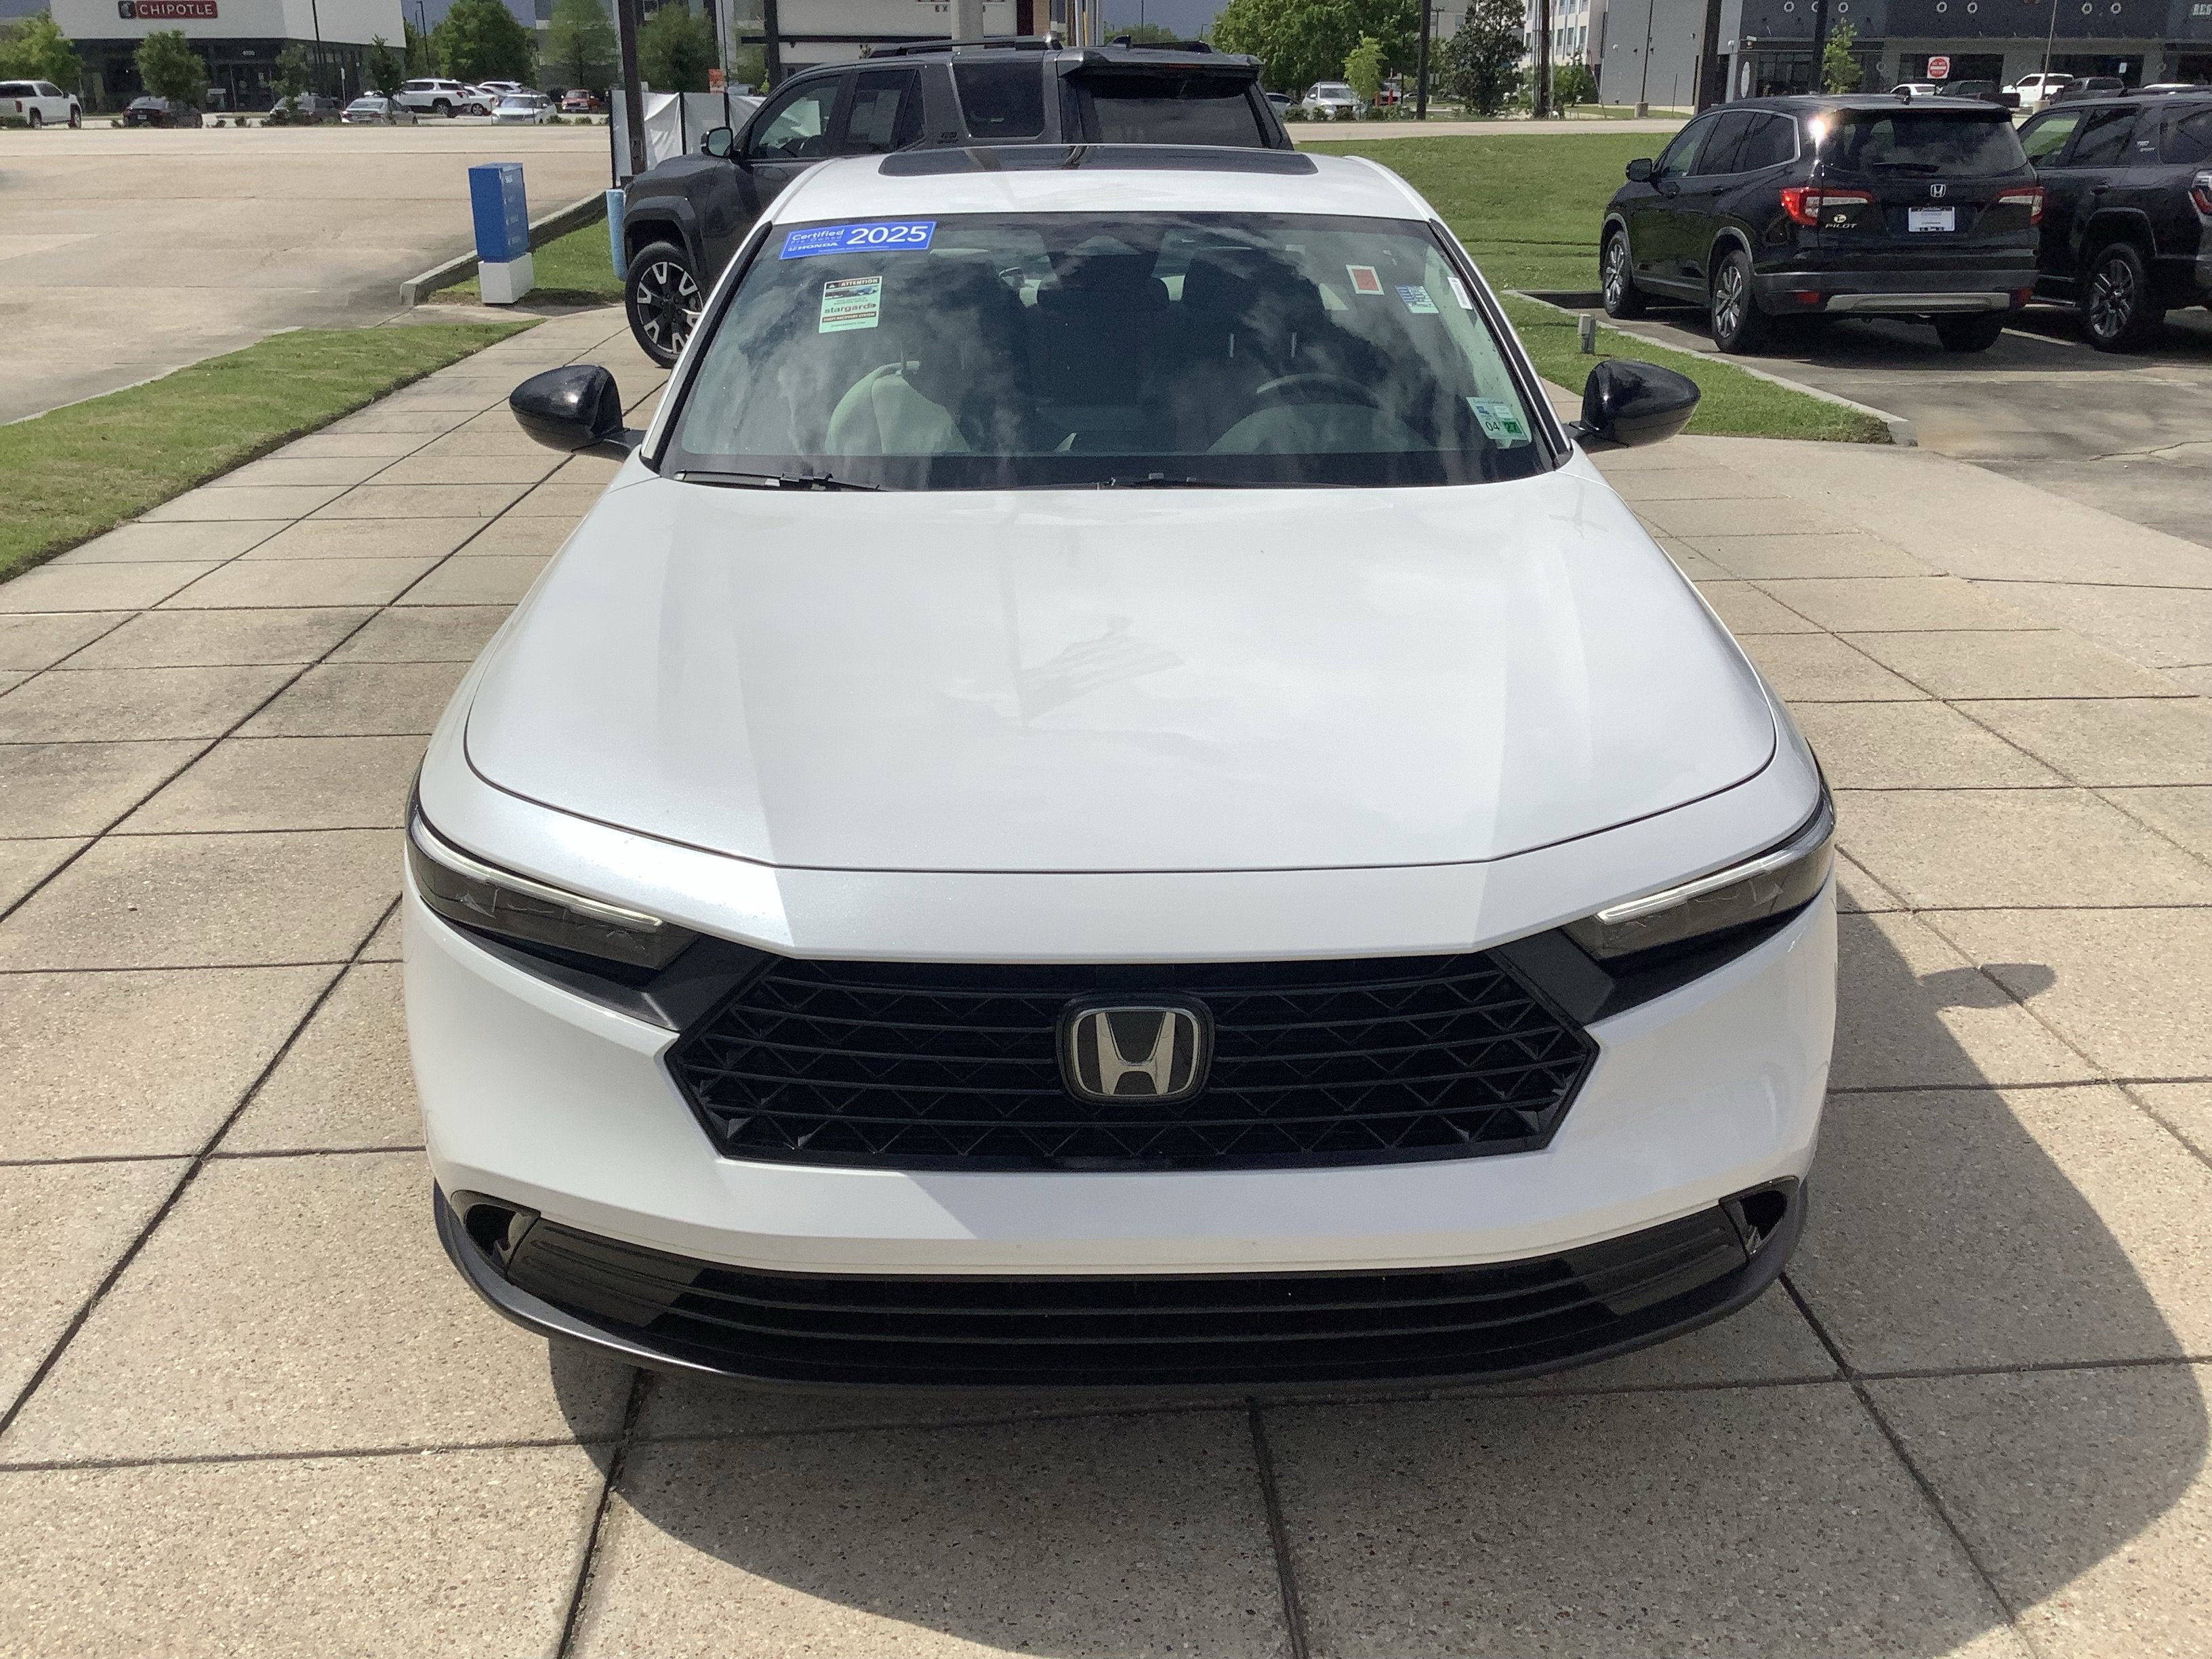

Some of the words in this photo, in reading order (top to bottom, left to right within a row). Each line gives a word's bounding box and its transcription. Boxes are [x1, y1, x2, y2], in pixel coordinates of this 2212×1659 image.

[140, 3, 213, 15] CHIPOTLE
[792, 229, 845, 241] Certified
[846, 226, 928, 245] 2025
[798, 241, 838, 249] HONDA
[841, 279, 878, 287] ATTENTION
[1485, 422, 1500, 431] 04
